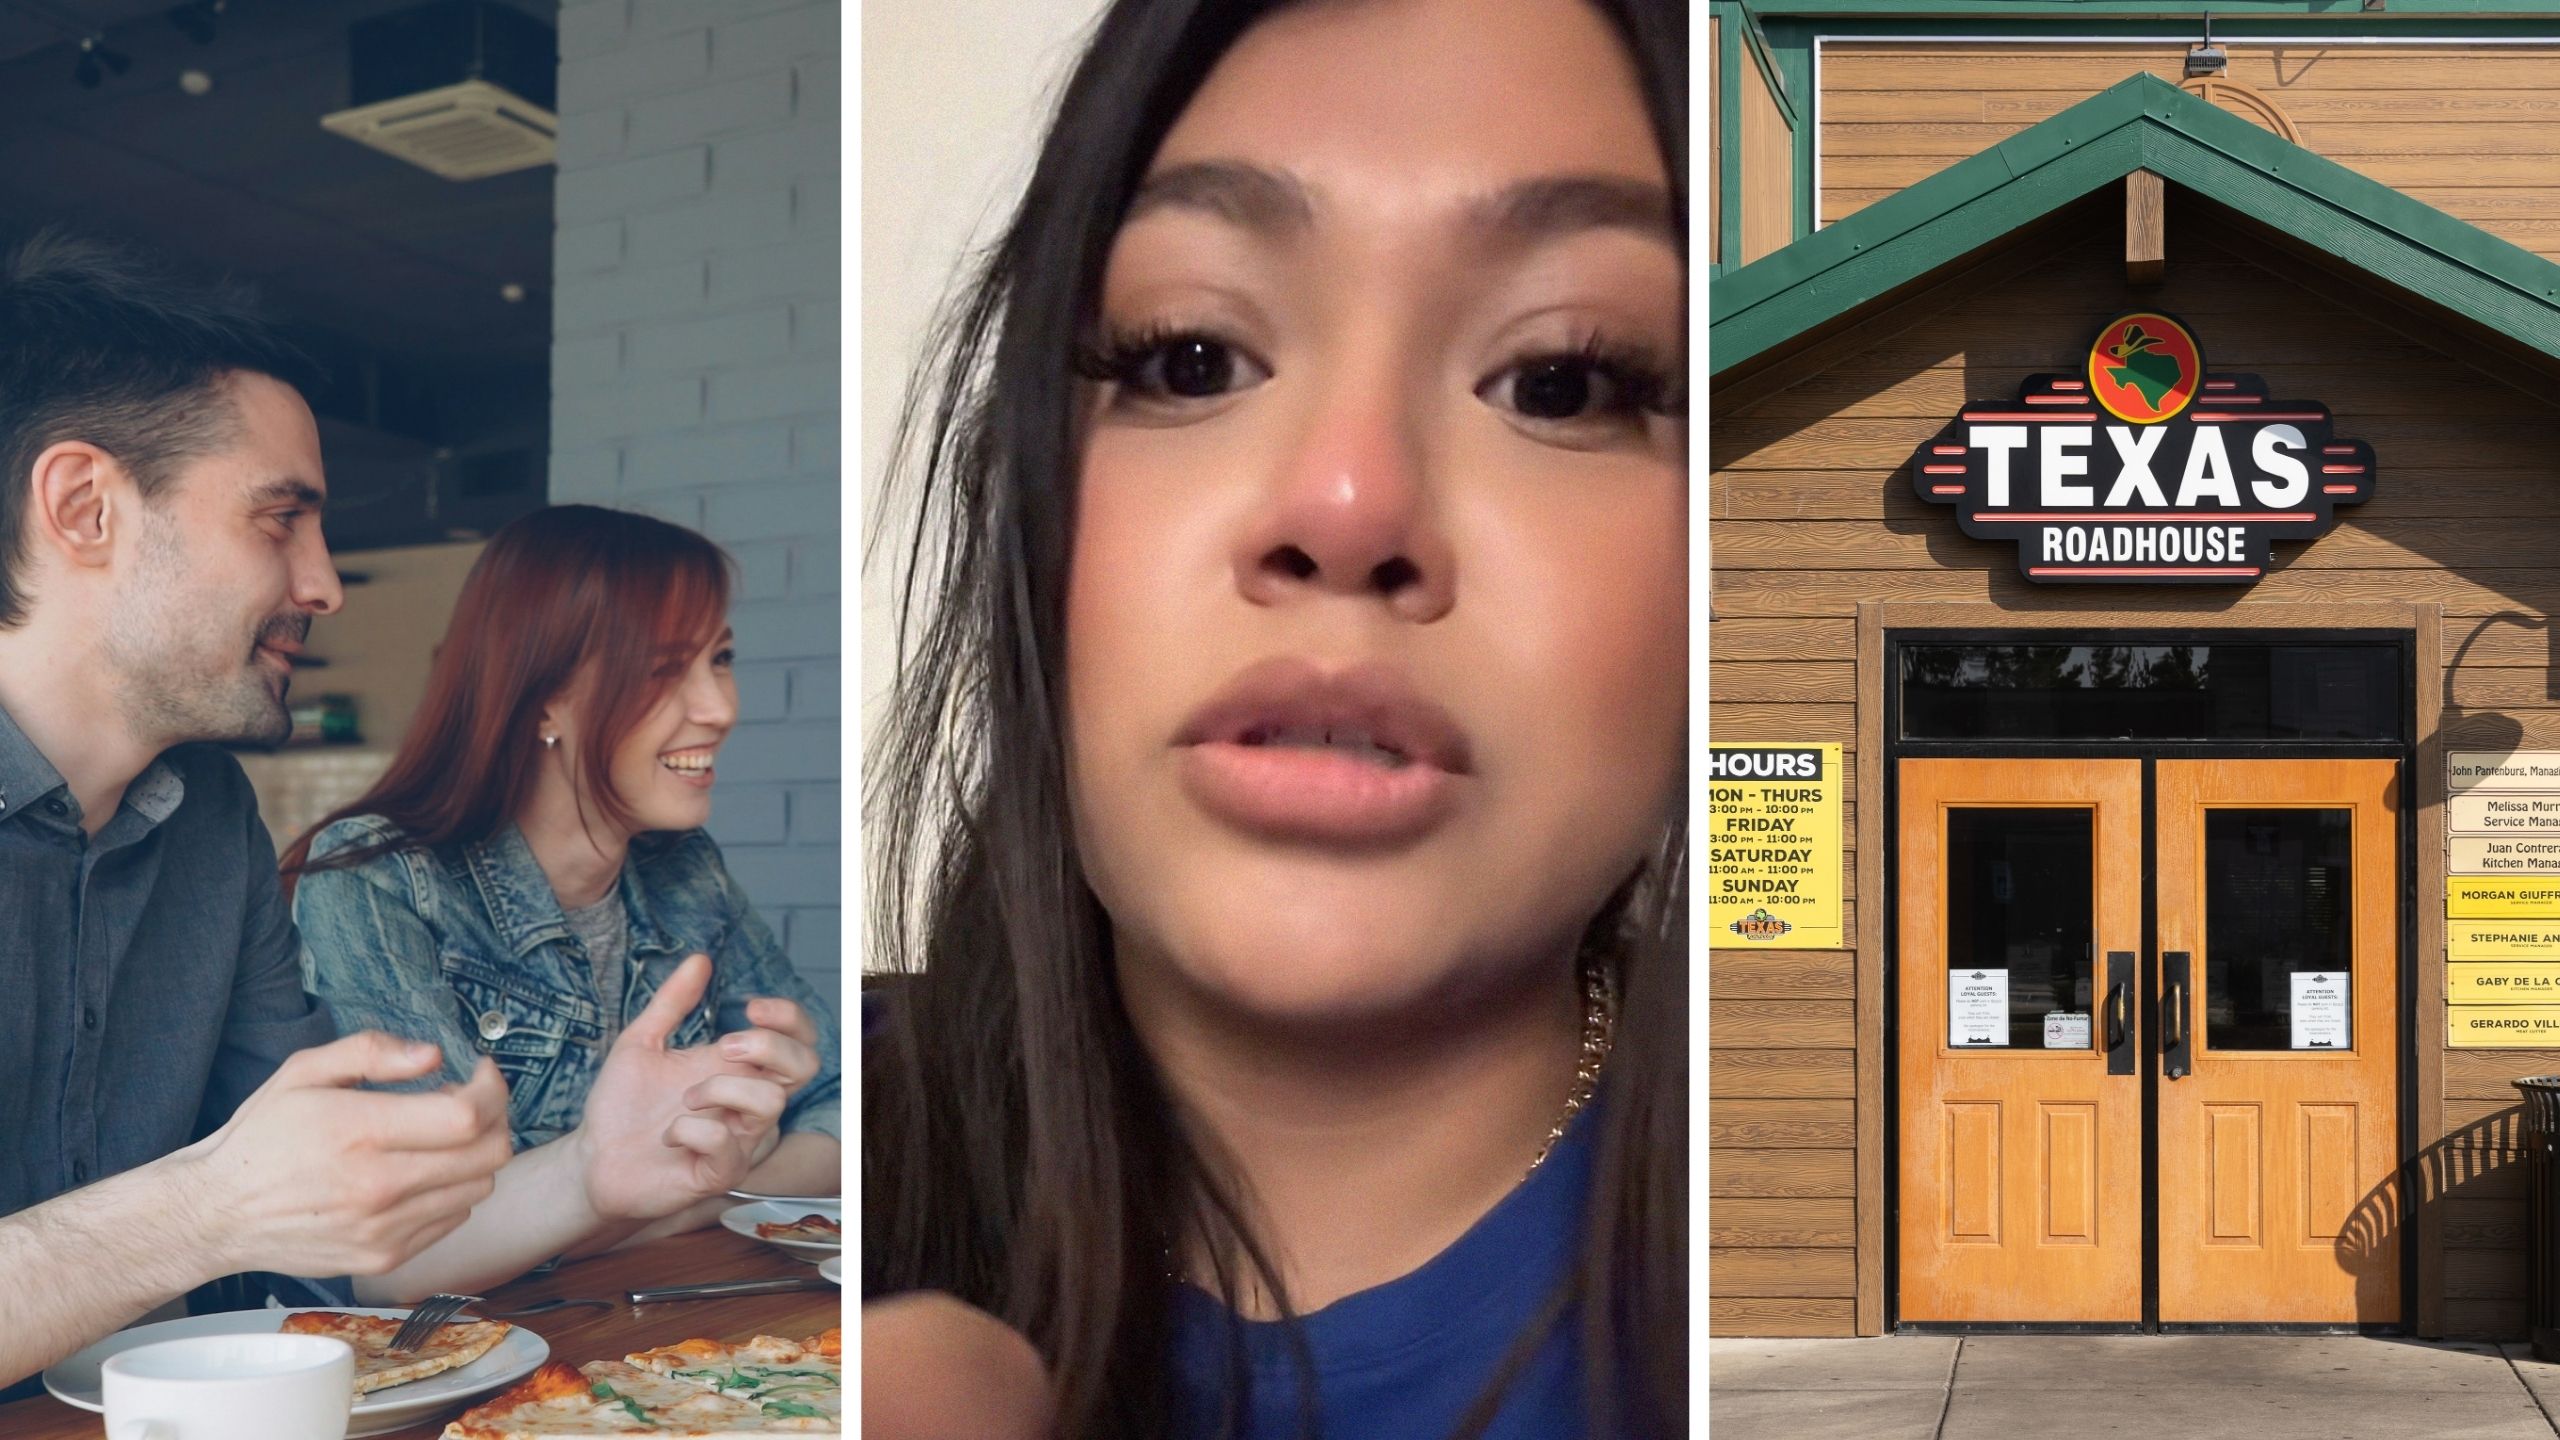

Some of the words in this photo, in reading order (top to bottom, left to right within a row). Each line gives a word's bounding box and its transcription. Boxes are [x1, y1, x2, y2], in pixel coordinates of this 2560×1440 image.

[1969, 423, 2310, 509] TEXAS
[2043, 526, 2245, 562] ROADHOUSE
[1709, 753, 1816, 777] HOURS
[2452, 766, 2472, 776] John
[1761, 788, 1823, 803] THURS
[1709, 804, 1738, 814] 3:00
[1740, 806, 1753, 814] PM
[1765, 804, 1799, 814] 10:00
[2487, 801, 2528, 812] Melissa
[1726, 818, 1796, 832] FRIDAY
[2484, 816, 2525, 827] Service
[2529, 816, 2560, 827] Mana
[1709, 834, 1738, 844] 3:00
[1766, 834, 1798, 844] 11:00
[1800, 836, 1813, 844] PM
[2486, 842, 2512, 854] Juan
[2516, 842, 2560, 854] Contrer
[1711, 848, 1813, 863] SATURDAY
[2482, 857, 2524, 869] Kitchen
[1709, 865, 1739, 874] 11:00
[1767, 865, 1798, 874] 11:00
[1722, 878, 1800, 893] SUNDAY
[1709, 895, 1738, 905] 11:00
[1740, 897, 1754, 905] AM
[1766, 895, 1801, 905] 10:00
[1802, 897, 1816, 905] PM
[2461, 890, 2515, 900] MORGAN
[1740, 920, 1783, 934] TEXAS
[2471, 933, 2538, 943] STEPHANIE
[2543, 934, 2560, 943] AN
[2476, 977, 2509, 986] GABY
[2514, 977, 2530, 986] DE
[2534, 977, 2550, 986] LA
[2470, 1019, 2530, 1029] GERARDO
